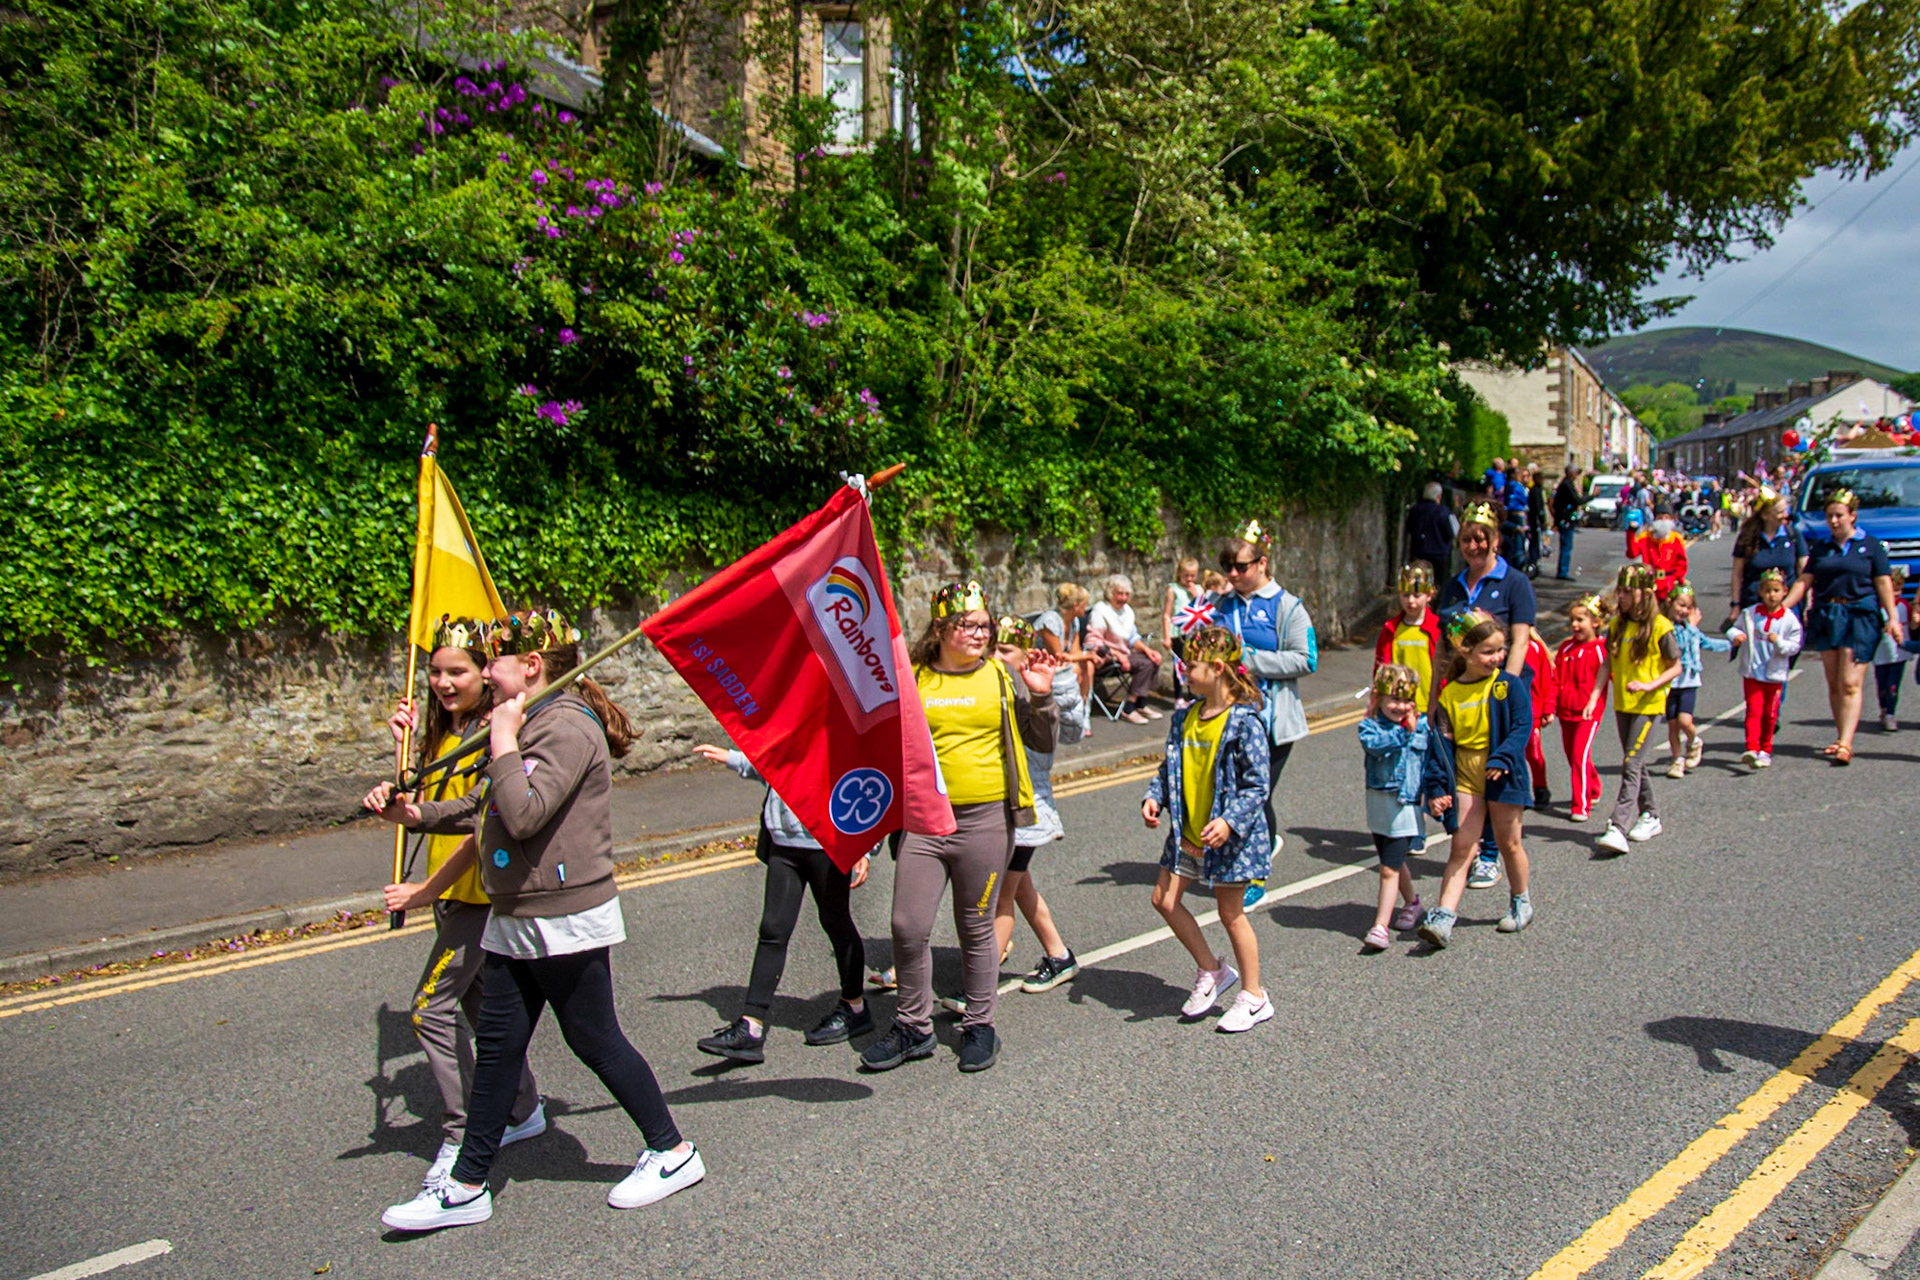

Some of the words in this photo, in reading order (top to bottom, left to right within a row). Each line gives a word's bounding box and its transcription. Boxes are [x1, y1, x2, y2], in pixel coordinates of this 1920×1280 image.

[687, 637, 714, 663] 1st
[706, 657, 760, 717] SABDEN
[824, 596, 894, 693] Rainbows
